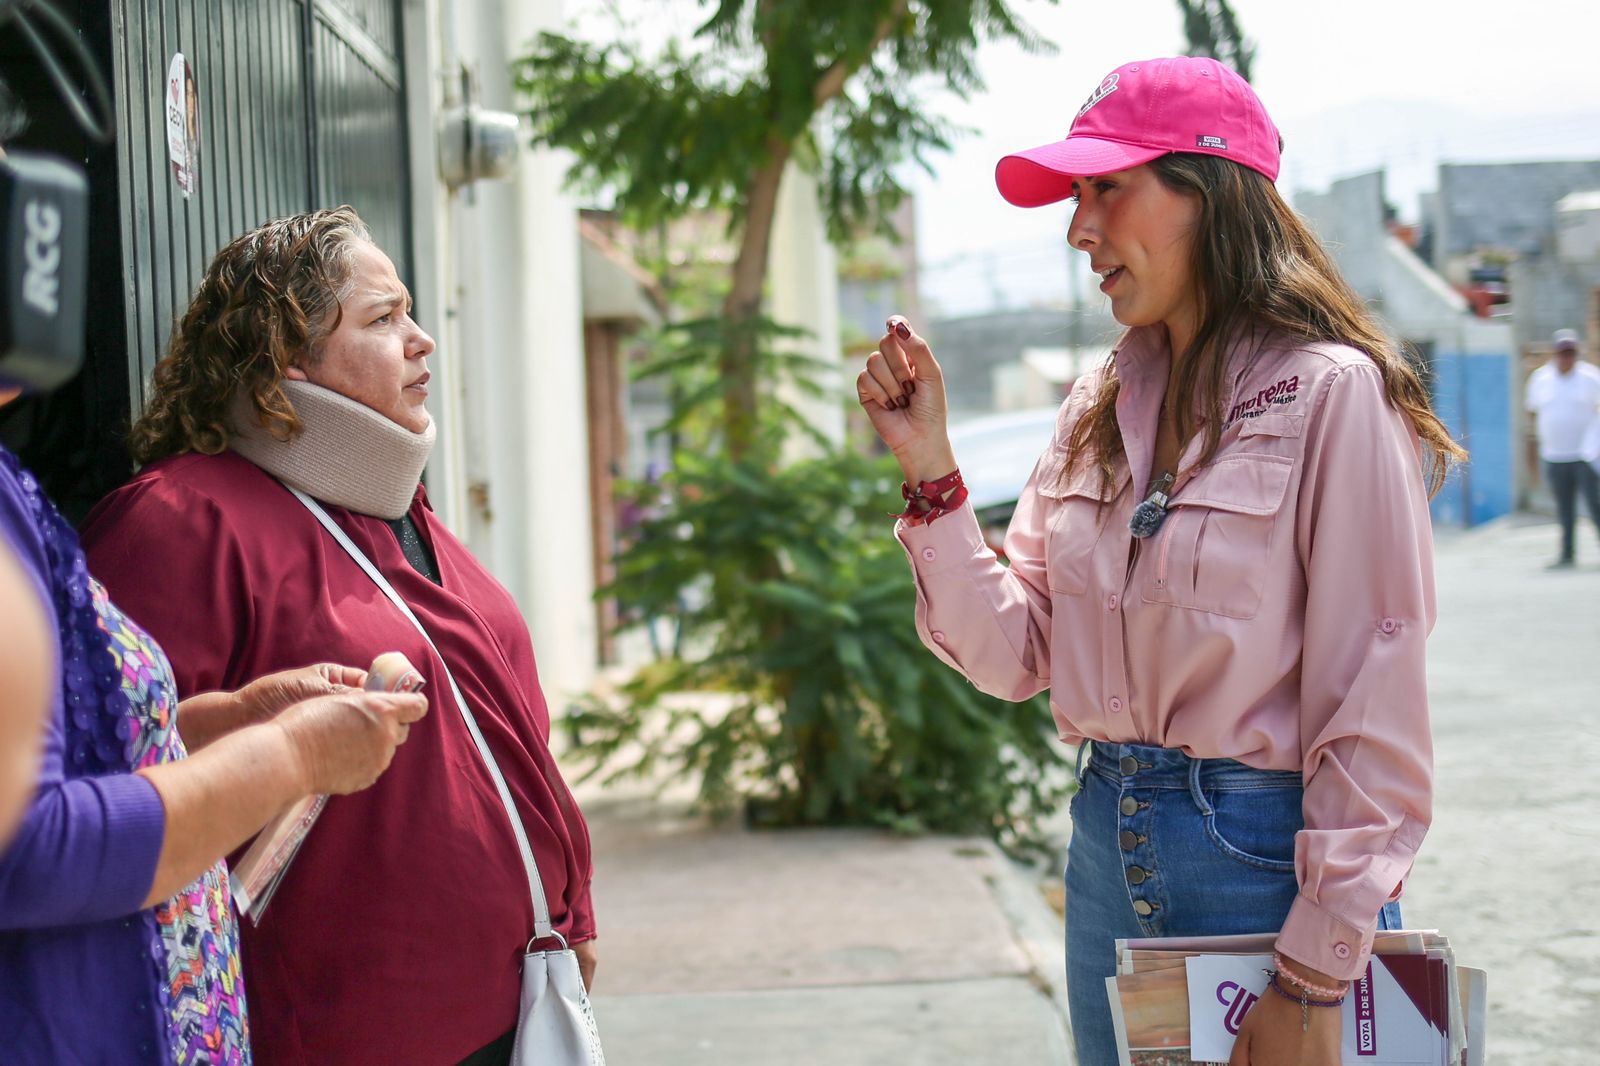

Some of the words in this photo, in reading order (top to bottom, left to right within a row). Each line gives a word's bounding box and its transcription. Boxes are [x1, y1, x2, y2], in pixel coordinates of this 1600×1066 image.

[23, 200, 62, 317] RCG
[1228, 375, 1299, 423] morena
[1360, 973, 1368, 995] JUN
[1361, 995, 1369, 1009] DE
